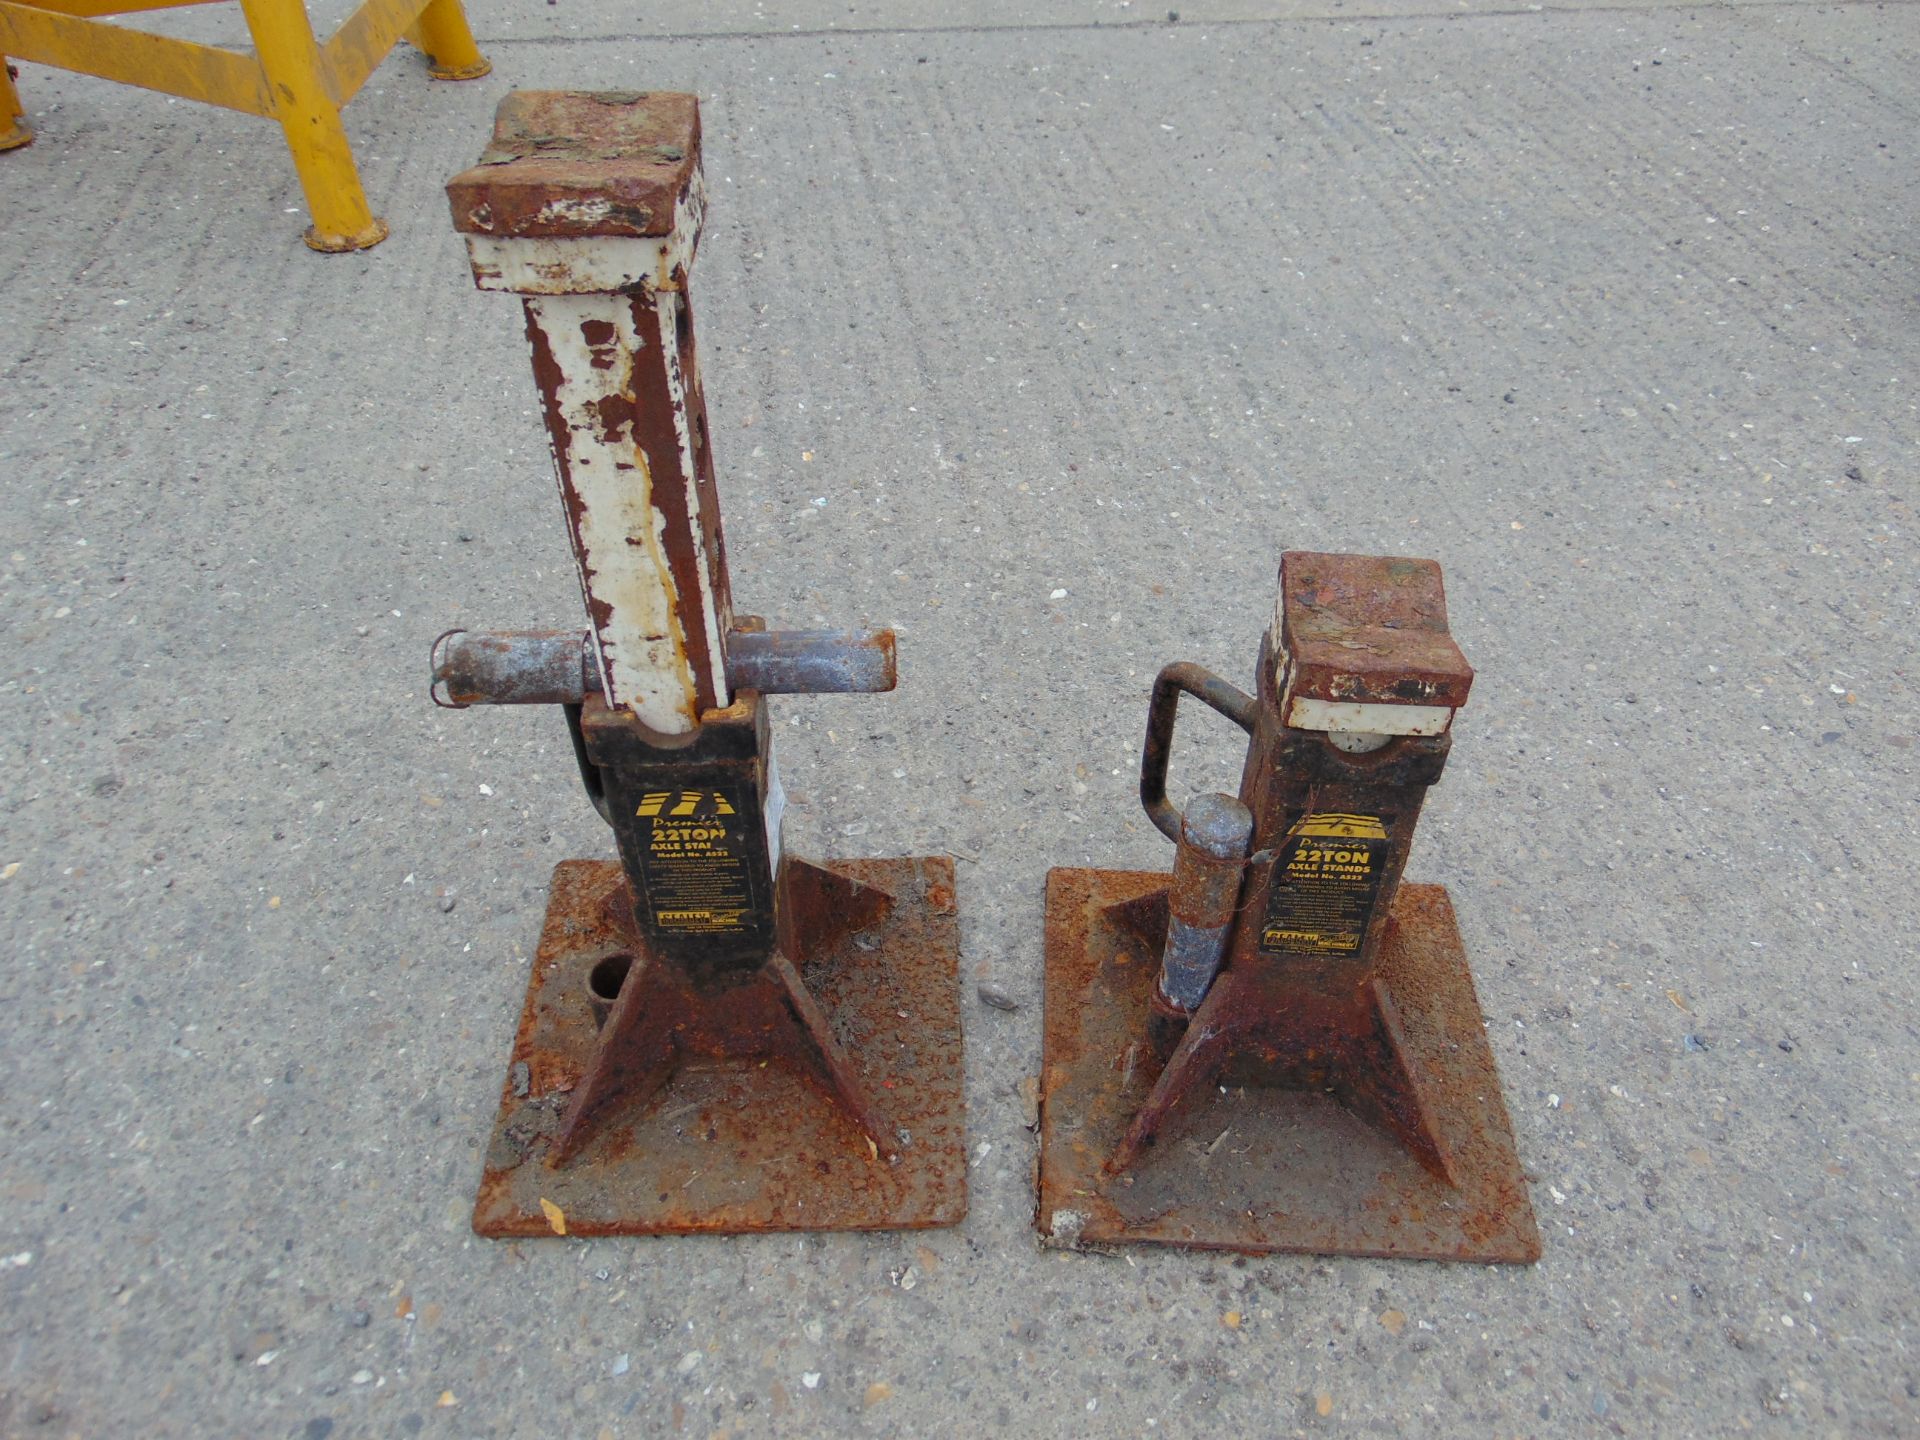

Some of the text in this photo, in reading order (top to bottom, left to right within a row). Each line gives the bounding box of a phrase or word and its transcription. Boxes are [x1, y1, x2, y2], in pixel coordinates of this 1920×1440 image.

[651, 829, 726, 841] 22TON
[650, 842, 681, 850] AXLE
[1299, 837, 1368, 849] Premier
[1294, 849, 1370, 864] 22TON
[1286, 863, 1371, 873] AXLE STANDS
